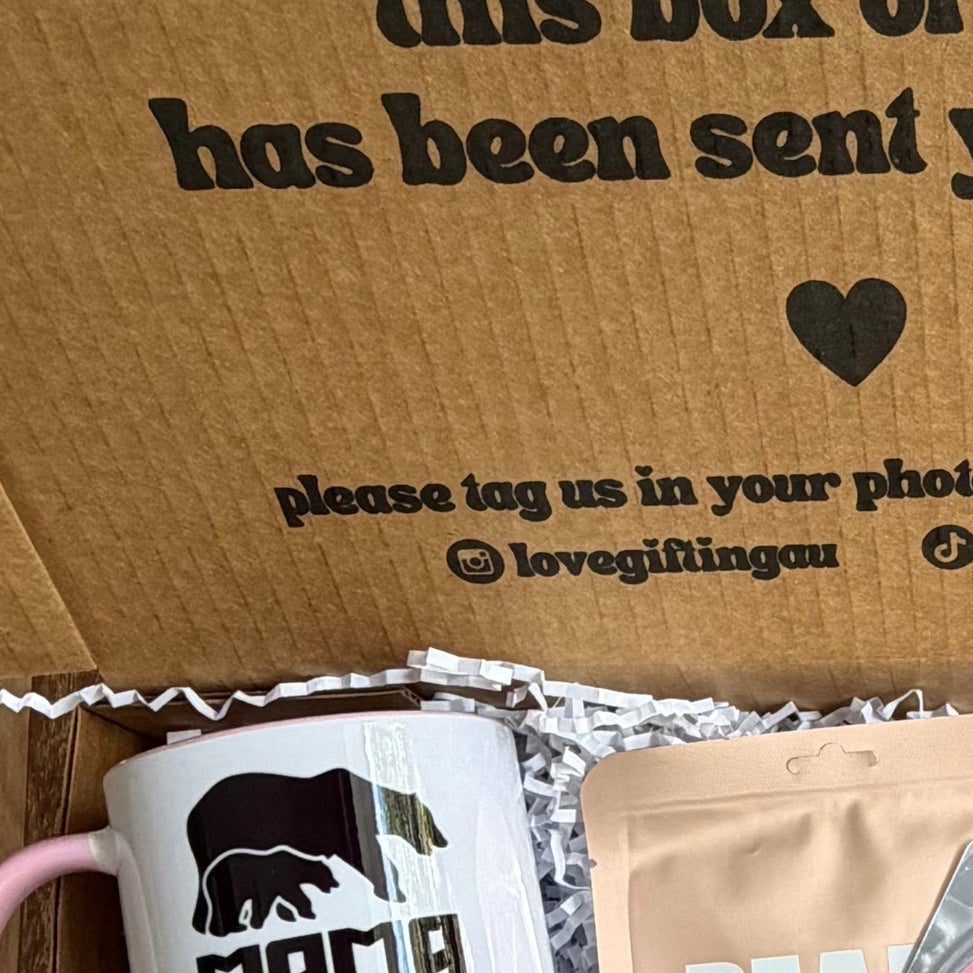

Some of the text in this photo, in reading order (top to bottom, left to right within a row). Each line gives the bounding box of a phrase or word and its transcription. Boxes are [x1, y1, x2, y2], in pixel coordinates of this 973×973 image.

[148, 97, 374, 190] has
[381, 93, 671, 186] been
[691, 87, 927, 180] sent
[274, 475, 456, 527] please
[462, 473, 553, 522] tag
[559, 474, 628, 508] us
[634, 465, 698, 507] in
[707, 470, 842, 516] your
[508, 537, 839, 584] lovegiftingau
